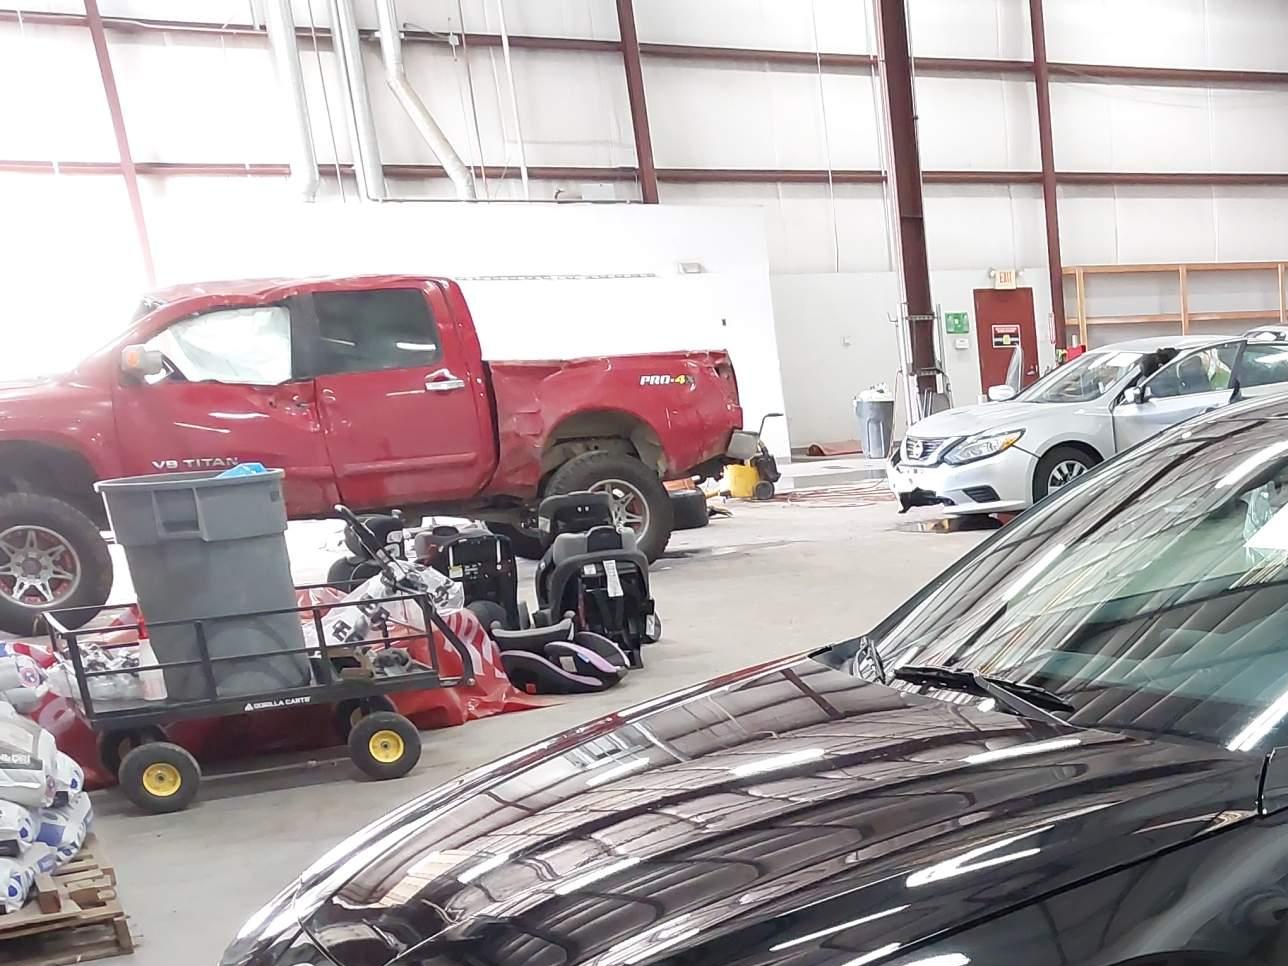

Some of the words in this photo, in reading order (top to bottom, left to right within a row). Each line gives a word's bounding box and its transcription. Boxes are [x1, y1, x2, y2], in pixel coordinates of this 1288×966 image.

[1000, 271, 1012, 284] EXIT
[152, 460, 178, 469] V8
[183, 457, 239, 468] TITAN
